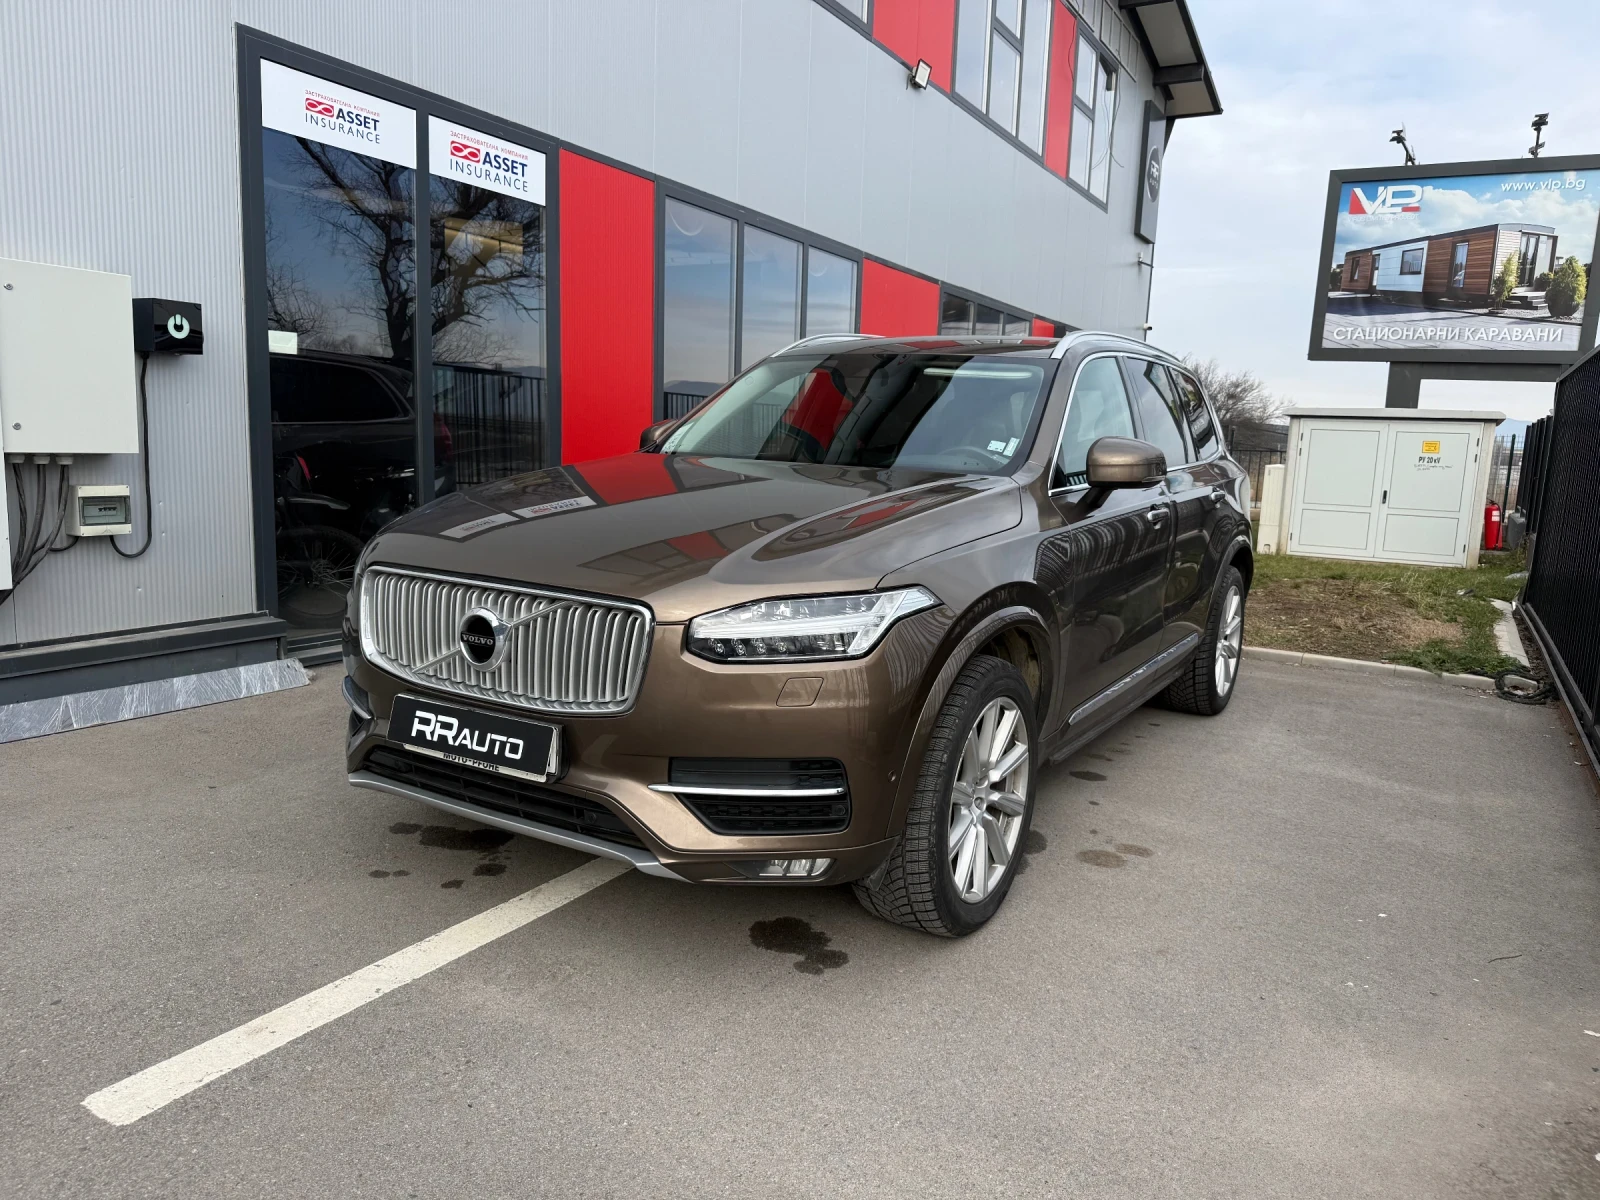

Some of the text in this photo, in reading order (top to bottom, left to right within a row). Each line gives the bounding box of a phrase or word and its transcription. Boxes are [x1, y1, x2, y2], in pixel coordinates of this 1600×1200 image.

[305, 113, 380, 144] INSURANCE
[336, 108, 380, 131] ASSET
[450, 130, 499, 151] ЗАСТРАХОВАТЕЛНА
[450, 158, 528, 193] INSURANCE
[482, 151, 528, 178] ASSET
[1501, 178, 1586, 192] www.vlp.bg
[1333, 326, 1563, 343] СТАЦИОНАРНИ КАРАВАНИ
[462, 633, 494, 646] VOLVO
